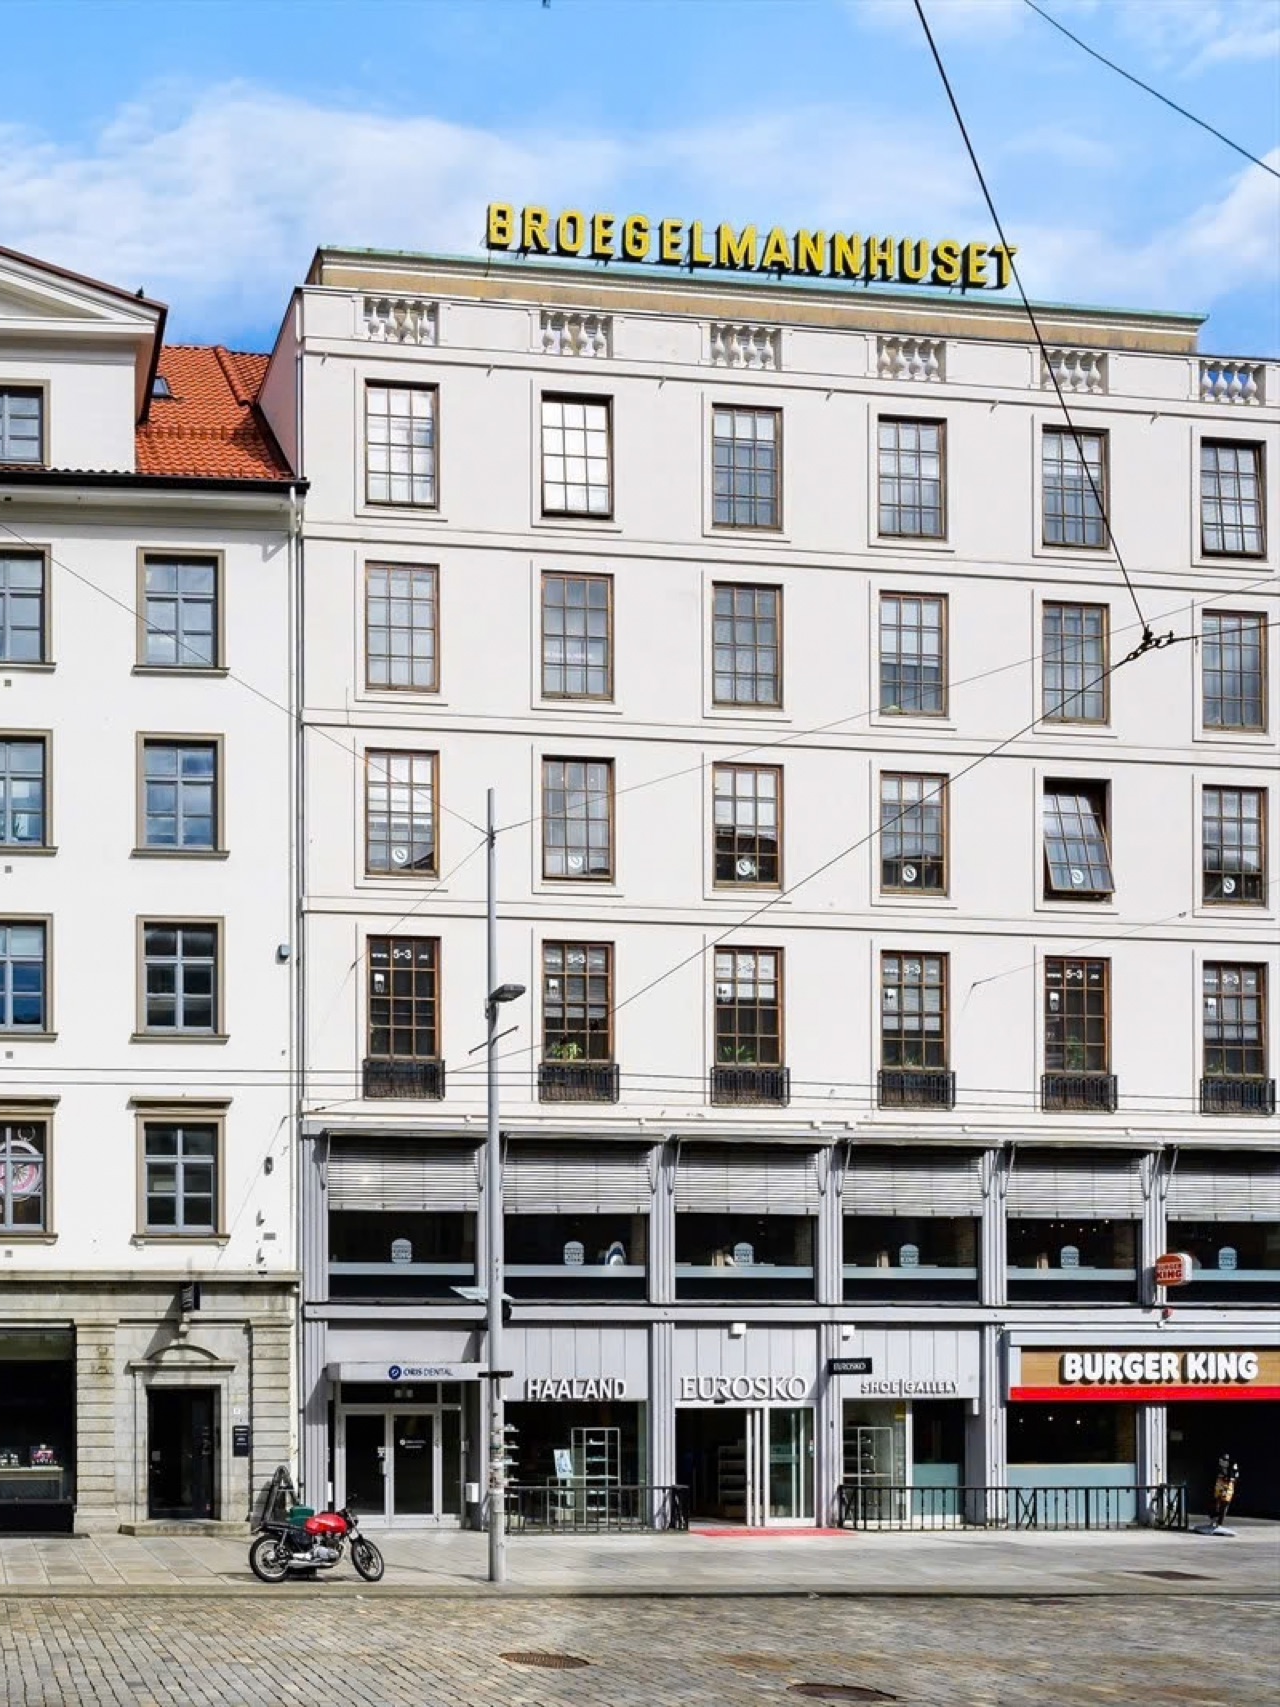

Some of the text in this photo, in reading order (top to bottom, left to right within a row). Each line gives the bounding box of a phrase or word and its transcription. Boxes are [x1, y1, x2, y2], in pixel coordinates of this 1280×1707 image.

[487, 203, 1018, 288] BROEGELMANNHUSET
[392, 948, 412, 959] 5-3
[1066, 969, 1083, 979] 5-3
[1156, 1270, 1182, 1279] KING
[423, 1367, 454, 1377] DENTAL
[1060, 1352, 1259, 1383] BURGER KING
[524, 1378, 627, 1400] HAALAND
[680, 1375, 809, 1401] EUROSKO
